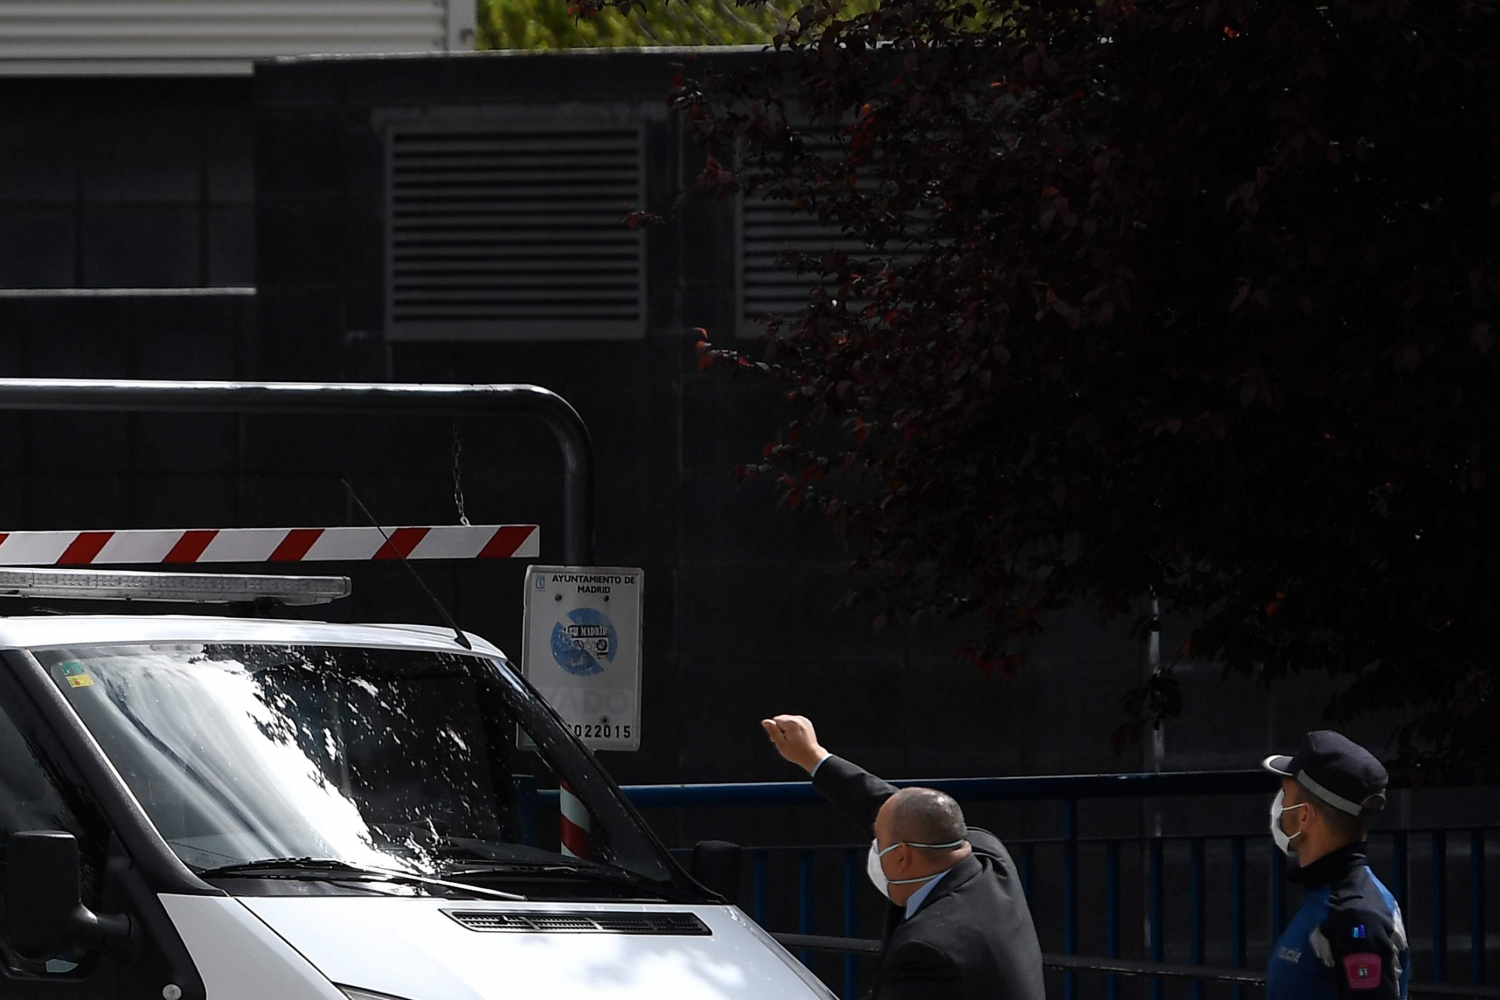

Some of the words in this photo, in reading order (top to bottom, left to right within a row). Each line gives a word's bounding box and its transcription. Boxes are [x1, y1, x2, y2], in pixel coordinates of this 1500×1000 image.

[552, 574, 622, 585] AYUNTAMIENTO
[624, 576, 636, 585] DE
[577, 585, 611, 594] MADRID
